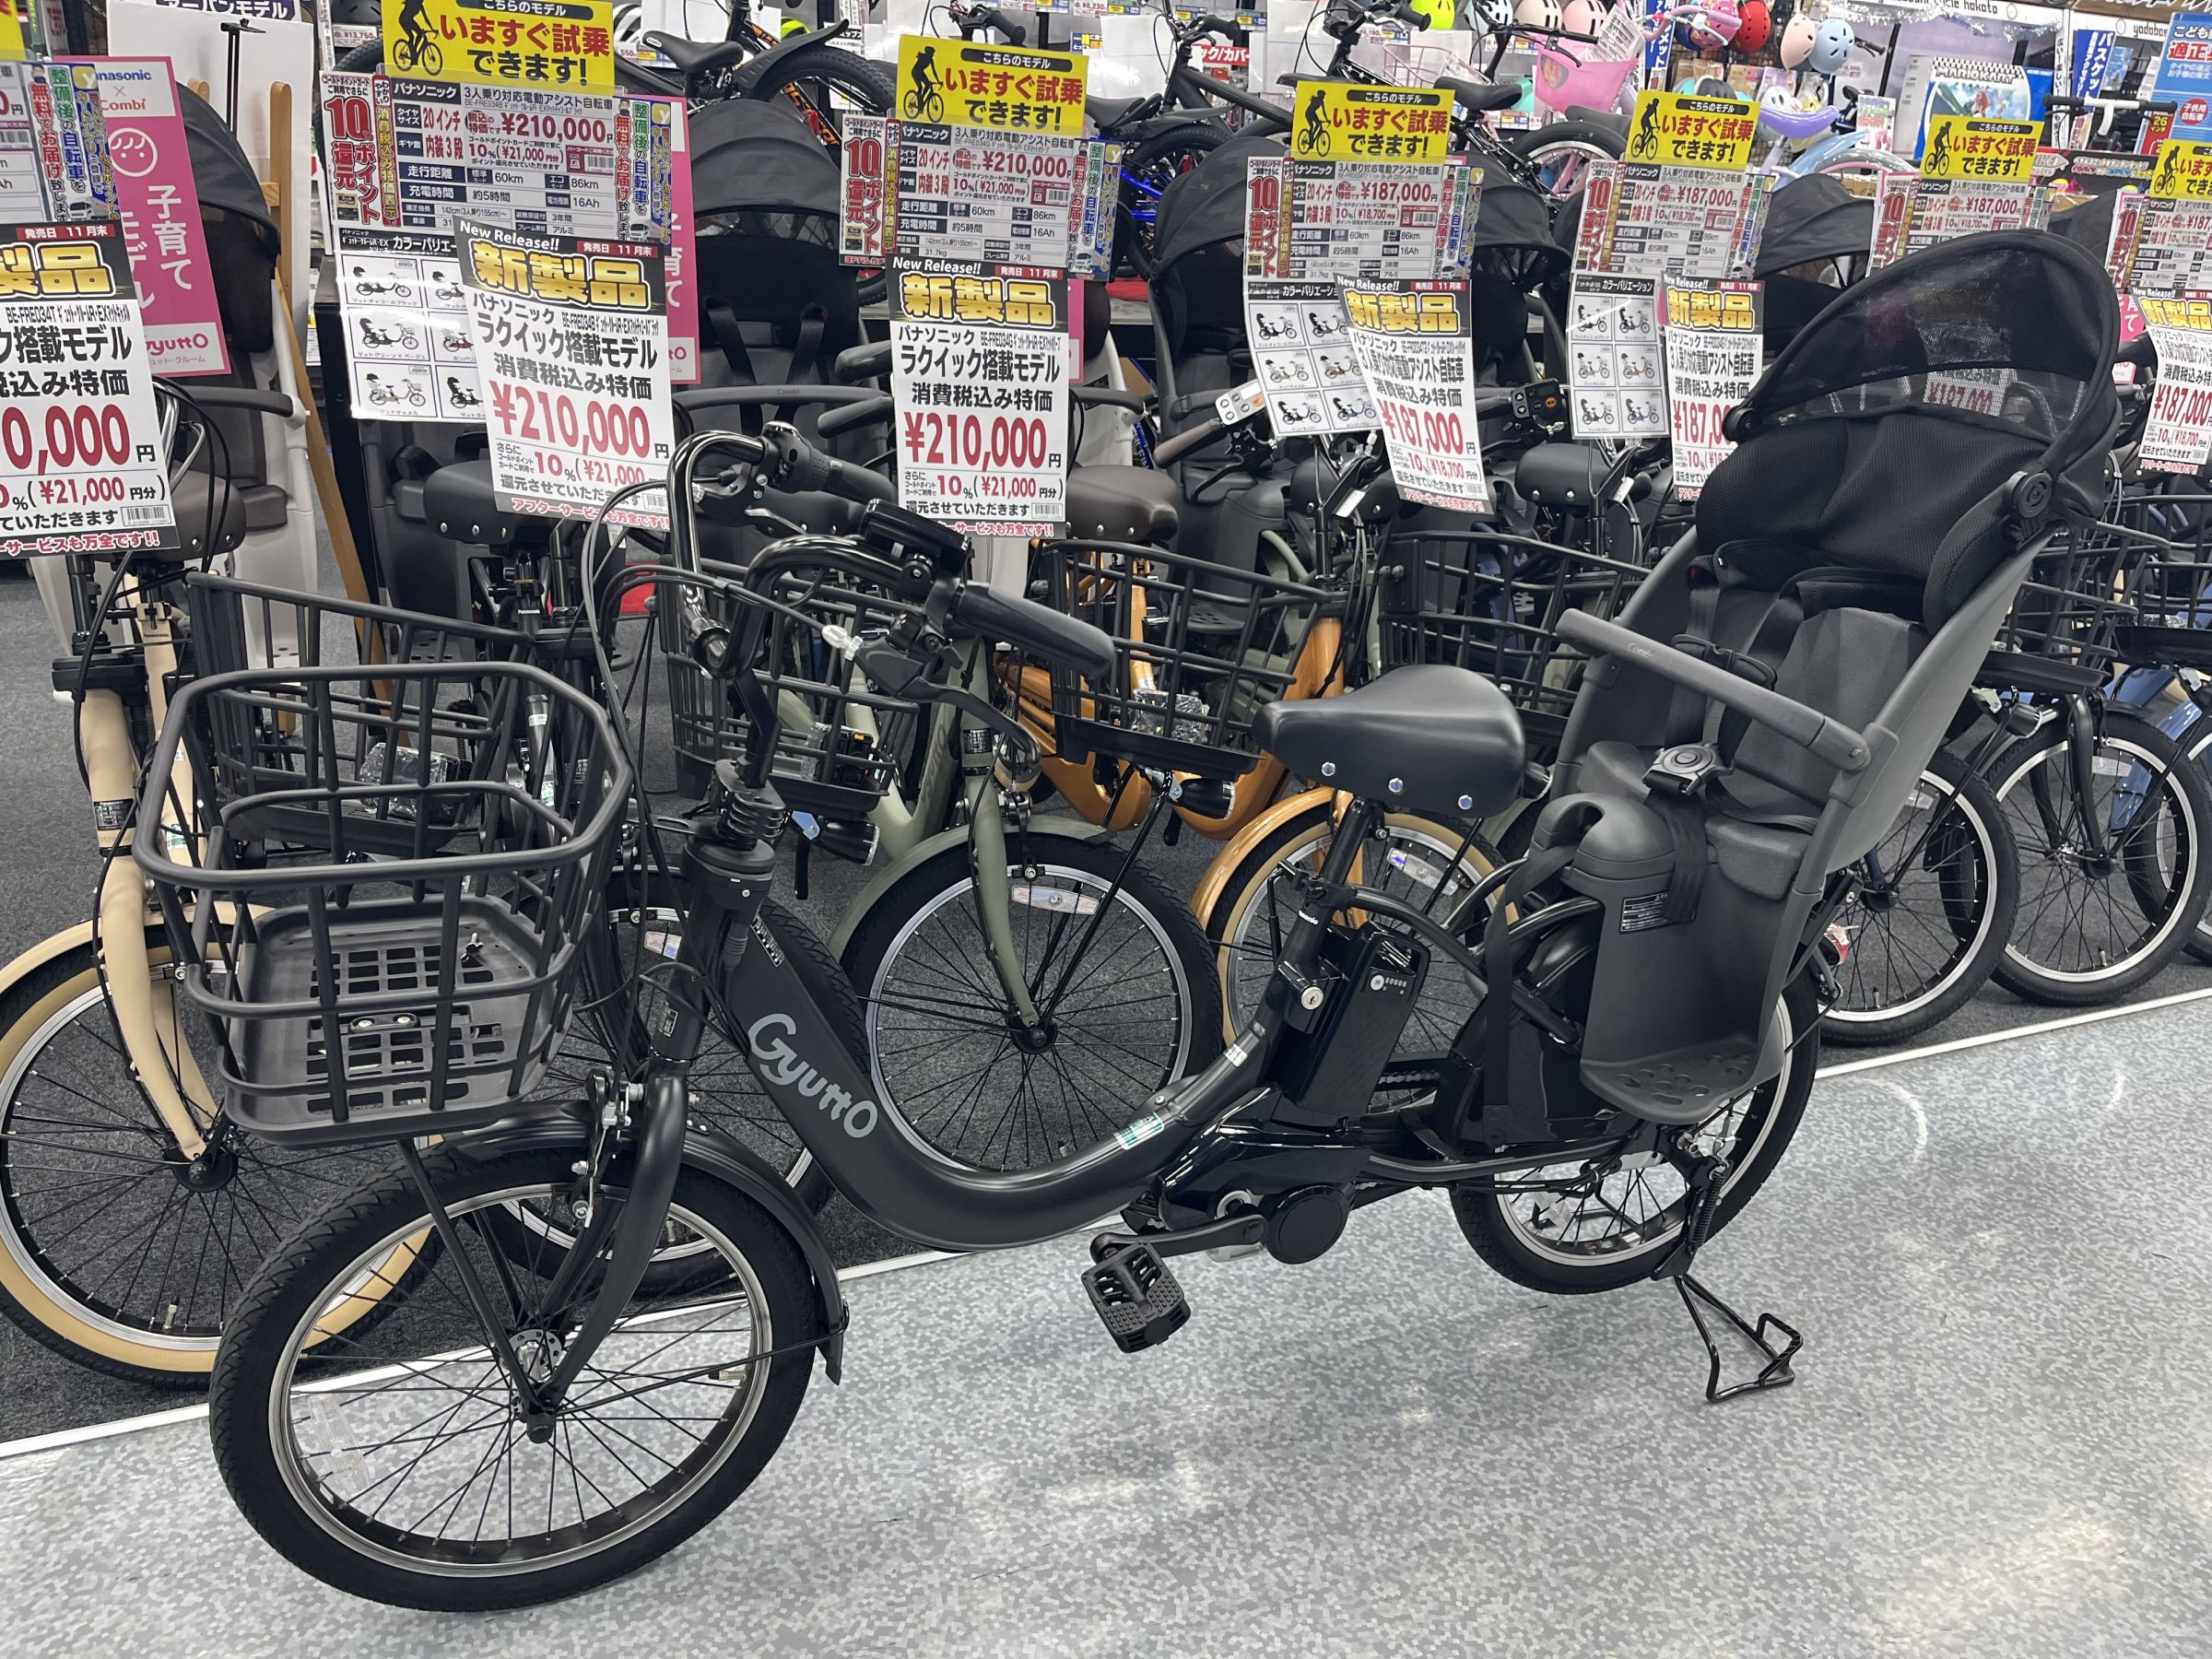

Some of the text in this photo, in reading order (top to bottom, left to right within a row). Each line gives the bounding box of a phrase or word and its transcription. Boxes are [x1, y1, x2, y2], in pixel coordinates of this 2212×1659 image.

[441, 14, 610, 57] いますぐ試乗
[466, 49, 587, 86] できます!
[982, 52, 1052, 70] こちらのモデル
[327, 85, 368, 97] ご利用でさらに
[394, 82, 457, 99] パナソニック
[945, 67, 1083, 105] いますぐ試乗
[464, 87, 613, 111] 3人乗り対応電動アシスト自転車
[1364, 91, 1422, 104] こちらのモデル
[1689, 100, 1735, 112] こちらのモデル
[396, 108, 418, 118] タイヤ
[397, 115, 420, 125] サイズ
[964, 100, 1062, 131] できます!
[1333, 107, 1448, 135] いますぐ試乗
[2153, 116, 2168, 126] 26
[501, 112, 606, 143] ¥210,000
[1661, 114, 1755, 142] いますぐ試乗
[1979, 123, 2020, 134] こちらのモデル
[1347, 134, 1429, 159] できます!
[1671, 139, 1736, 162] できます!
[1953, 135, 2037, 158] いますぐ試乗
[334, 142, 356, 190] 還元
[632, 101, 649, 216] 整備後の自転車を
[982, 150, 1068, 179] ¥210,000
[1961, 157, 2019, 177] できます!
[407, 166, 453, 180] 走行距離
[495, 173, 524, 184] 60km
[549, 175, 565, 183] エコ
[614, 114, 631, 241] 無料でお届け致します
[1625, 167, 1659, 177] パナソニック
[356, 143, 379, 226] ポイント
[409, 185, 454, 199] 充電時間
[571, 178, 599, 190] 86km
[1360, 182, 1431, 204] ¥187,000
[473, 190, 511, 202] 約5時間
[573, 197, 600, 208] 16Ah
[846, 178, 865, 223] 還元
[1677, 185, 1733, 207] ¥187,000
[900, 201, 938, 214] 走行距離
[971, 206, 995, 217] 60km
[1966, 197, 2018, 215] ¥187,000
[552, 214, 572, 222] 3年間
[864, 179, 882, 254] ポイント
[900, 218, 937, 231] 充電時間
[1033, 211, 1056, 221] 86km
[24, 228, 57, 239] 発売日
[460, 221, 560, 251] New Release!!
[553, 226, 574, 234] アルミ
[952, 222, 982, 234] 約5時間
[1033, 229, 1055, 238] 16Ah
[1349, 230, 1370, 241] 60km
[1400, 231, 1420, 241] 86km
[582, 242, 609, 253] 発売日
[1014, 243, 1031, 252] 3年間
[1401, 247, 1419, 255] 16Ah
[893, 257, 982, 275] New Release!!
[1000, 267, 1023, 276] 発売日
[471, 240, 651, 311] 新製品
[1336, 276, 1400, 291] New Release!!
[1663, 276, 1709, 290] New Release!!
[1415, 281, 1433, 290] 発売日
[1602, 278, 1653, 292] カラーバリエーション
[473, 292, 555, 324] パナソニック
[900, 271, 1055, 329] 新製品
[1345, 290, 1460, 335] 新製品
[1666, 286, 1756, 334] 新製品
[2138, 297, 2212, 332] 新製品
[477, 312, 658, 370] ラクイック搭載モデル
[899, 325, 975, 346] パナソニック
[1354, 334, 1397, 352] パナソニック
[1668, 330, 1702, 347] パナソニック
[900, 345, 1060, 383] ラクイック搭載モデル
[494, 352, 653, 400] 消費税込み特価
[912, 382, 1053, 412] 消費税込み特価
[1373, 376, 1463, 407] 消費税込み特価
[1675, 377, 1750, 400] 消費税込み特価
[488, 380, 651, 459] ¥210,000
[1376, 398, 1464, 455] ¥187,000
[496, 441, 522, 455] さらに
[903, 411, 1047, 472] ¥210,000
[904, 470, 926, 481] さらに
